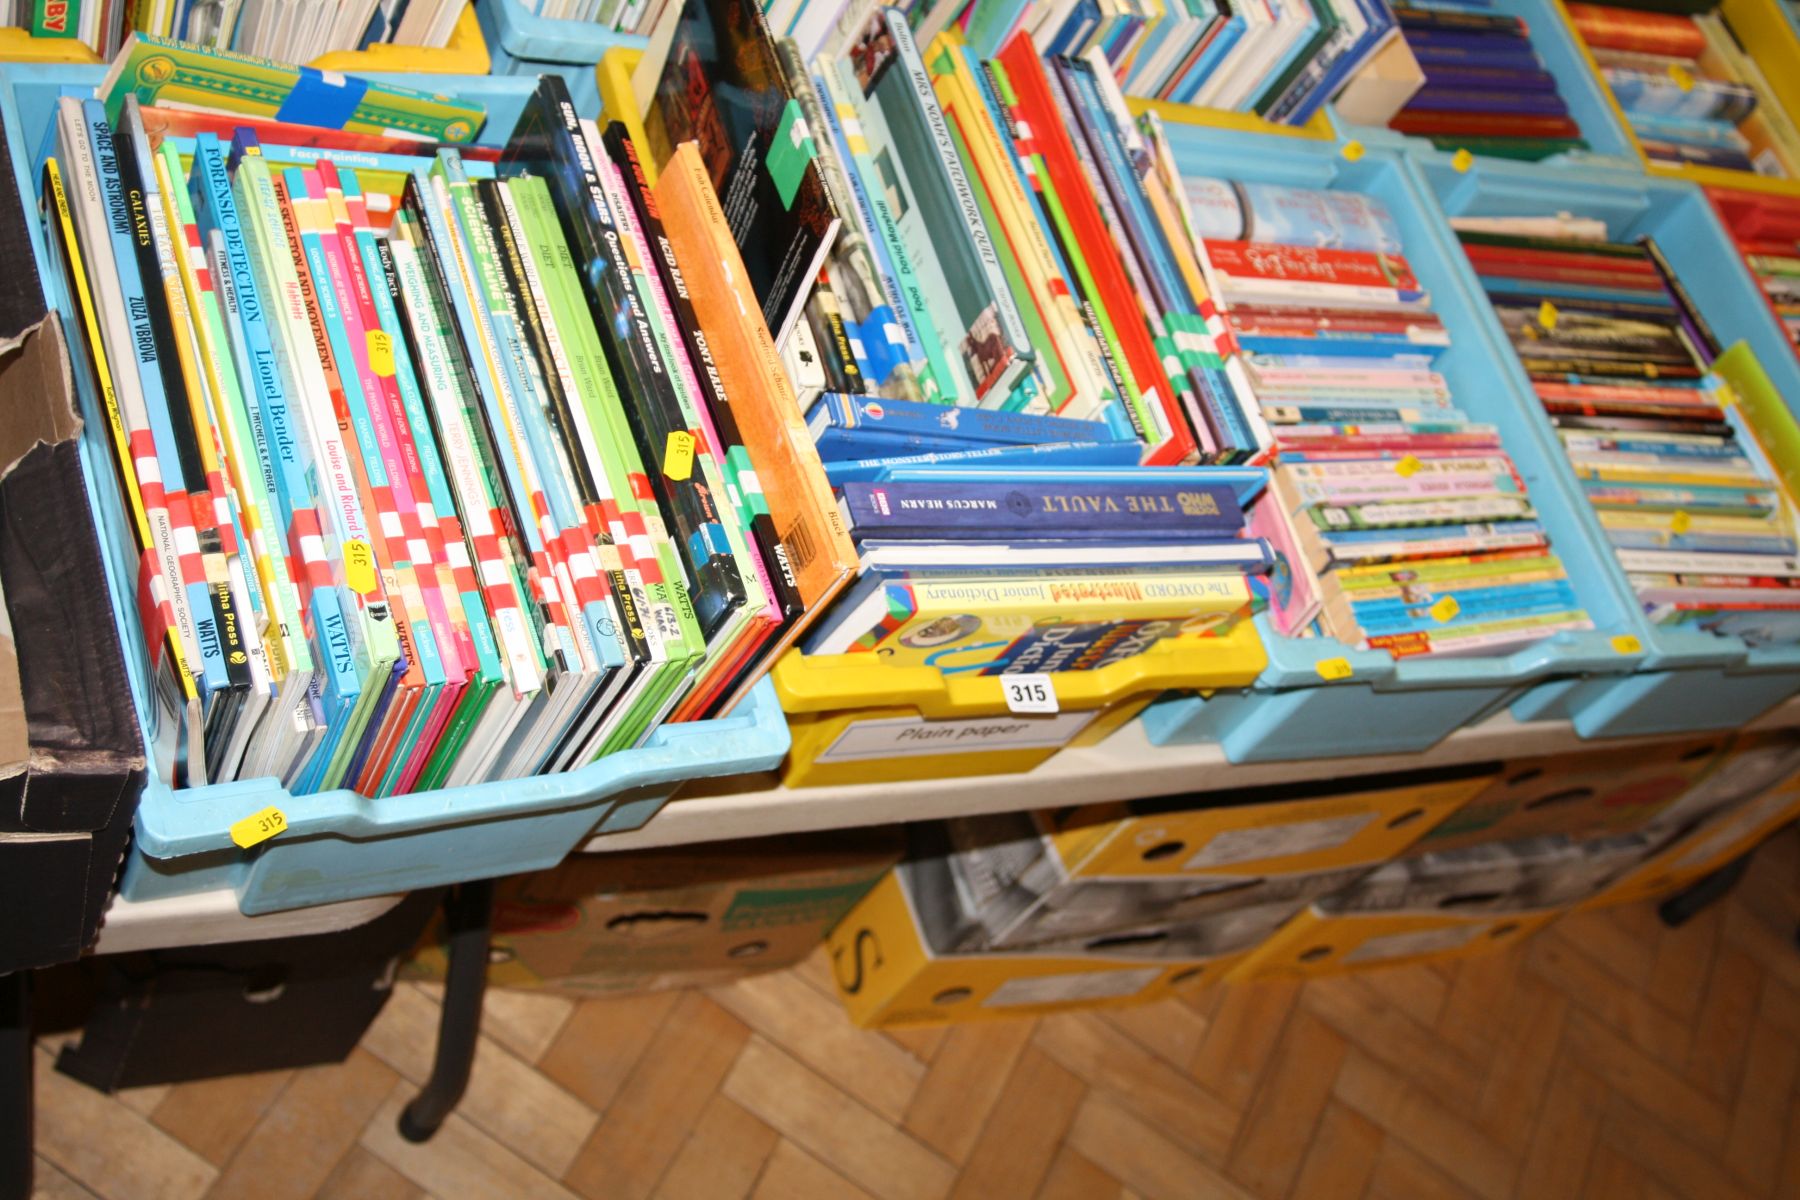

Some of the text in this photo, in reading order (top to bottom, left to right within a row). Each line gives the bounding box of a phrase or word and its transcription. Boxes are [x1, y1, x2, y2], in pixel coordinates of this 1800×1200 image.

[290, 150, 380, 166] Face Painting
[912, 67, 930, 98] MRS
[926, 100, 950, 148] NOAH'S
[945, 148, 982, 229] PATCHWORK
[974, 228, 996, 268] QUILT
[610, 190, 633, 233] DISASTERS
[344, 234, 359, 264] LOOKING
[558, 98, 666, 376] SUN, MOON & STARS Questions and Answers
[215, 248, 232, 279] FITNESS
[353, 263, 361, 273] AT
[377, 243, 401, 297] Body Facts
[873, 197, 925, 313] Food David Marshall
[166, 278, 186, 318] SPACE
[223, 278, 232, 286] &
[355, 272, 369, 299] SCIENCE
[460, 195, 535, 395] SCIENCE ALIVE Around
[223, 285, 239, 315] HEALTH
[285, 280, 303, 320] Habitats
[895, 304, 907, 320] TO
[539, 244, 597, 400] DIET Brian Ward
[900, 319, 917, 345] HOW
[375, 334, 388, 354] 315
[535, 294, 574, 394] THE MUSCLES
[73, 117, 190, 639] LET'S GO TO THE MOON NATIONAL GEOGRAPHIC SOCIETY
[326, 249, 402, 490] LOOKING AT SCIENCE THE PHYSICAL WORLD FIELDING
[621, 136, 637, 162] SAVE
[640, 183, 660, 221] EARTH
[658, 235, 677, 268] ACID
[670, 266, 690, 301] RAIN
[693, 328, 714, 366] TONY
[706, 364, 728, 403] HARE
[774, 543, 797, 588] WATTS
[700, 185, 722, 226] Calendar
[828, 511, 844, 538] Black
[93, 119, 221, 659] SPACE AND ASTRONOMY ZUZA VBROVA WATTS
[401, 260, 481, 507] WEIGHING AND MEASURING TERRY JENNINGS
[129, 189, 239, 646] GALAXIES Press
[204, 147, 354, 674] FORENSIC DETECTION Lionel Bender WATTS
[391, 397, 401, 417] FIRST
[52, 172, 192, 678] HEAT WATTS
[250, 409, 267, 447] TATCHELL
[272, 181, 416, 668] THE SKELETON AND MOVEMENT WATTS
[396, 416, 406, 436] LOOK
[557, 244, 694, 621] DIET Brian Ward WATTS
[259, 446, 267, 454] &
[260, 454, 270, 464] K.
[309, 246, 434, 659] LOOKING AT SCIENCE CHANGES FIELDING Blackwell
[325, 437, 346, 471] Louise
[404, 442, 418, 474] FIELDING
[676, 435, 691, 456] 315
[860, 455, 930, 468] THE MONSTER
[261, 463, 277, 495] FRASER
[334, 470, 350, 492] and
[339, 491, 364, 538] Richard
[900, 495, 1175, 512] THE VAULT MARCUS HEARN
[354, 543, 366, 567] 315
[621, 592, 638, 623] Press
[926, 582, 1232, 603] The OXFORD Illustrated Junior Dictionary
[476, 620, 492, 655] Blackwell
[1011, 684, 1046, 703] 315
[896, 723, 1030, 741] Plain paper
[258, 812, 283, 832] 315
